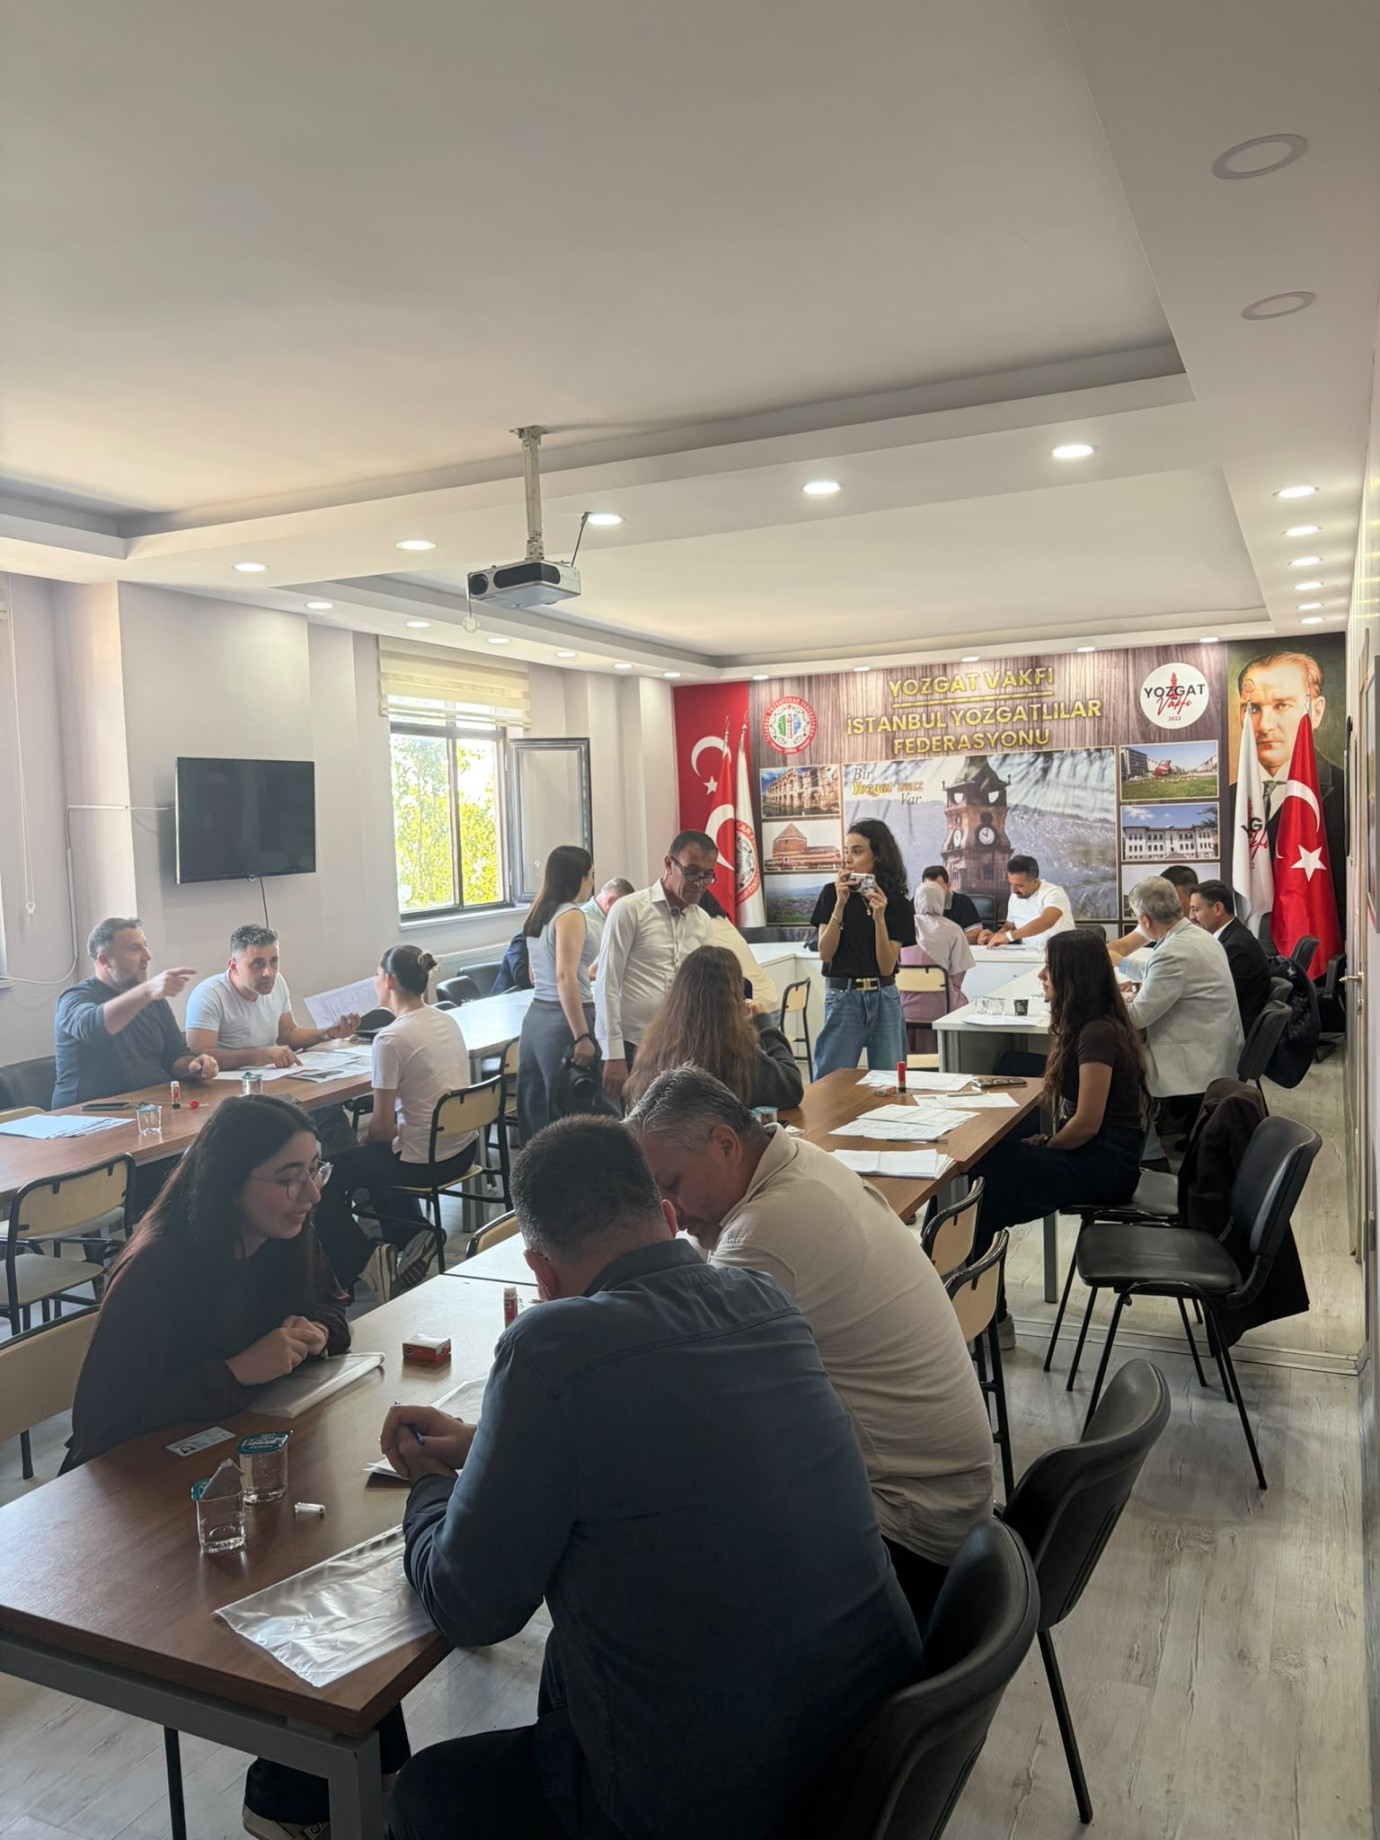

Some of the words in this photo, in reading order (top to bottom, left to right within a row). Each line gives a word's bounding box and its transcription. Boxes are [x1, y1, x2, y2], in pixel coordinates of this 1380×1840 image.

[889, 673, 979, 697] YOZGAT
[985, 667, 1053, 689] VAKFI
[1144, 684, 1205, 698] YOZGAT
[847, 711, 946, 735] İSTANBUL
[951, 699, 1101, 727] YOZGATLILAR
[893, 728, 1050, 754] FEDERASYONU
[853, 767, 873, 780] Bir
[901, 792, 922, 805] Var
